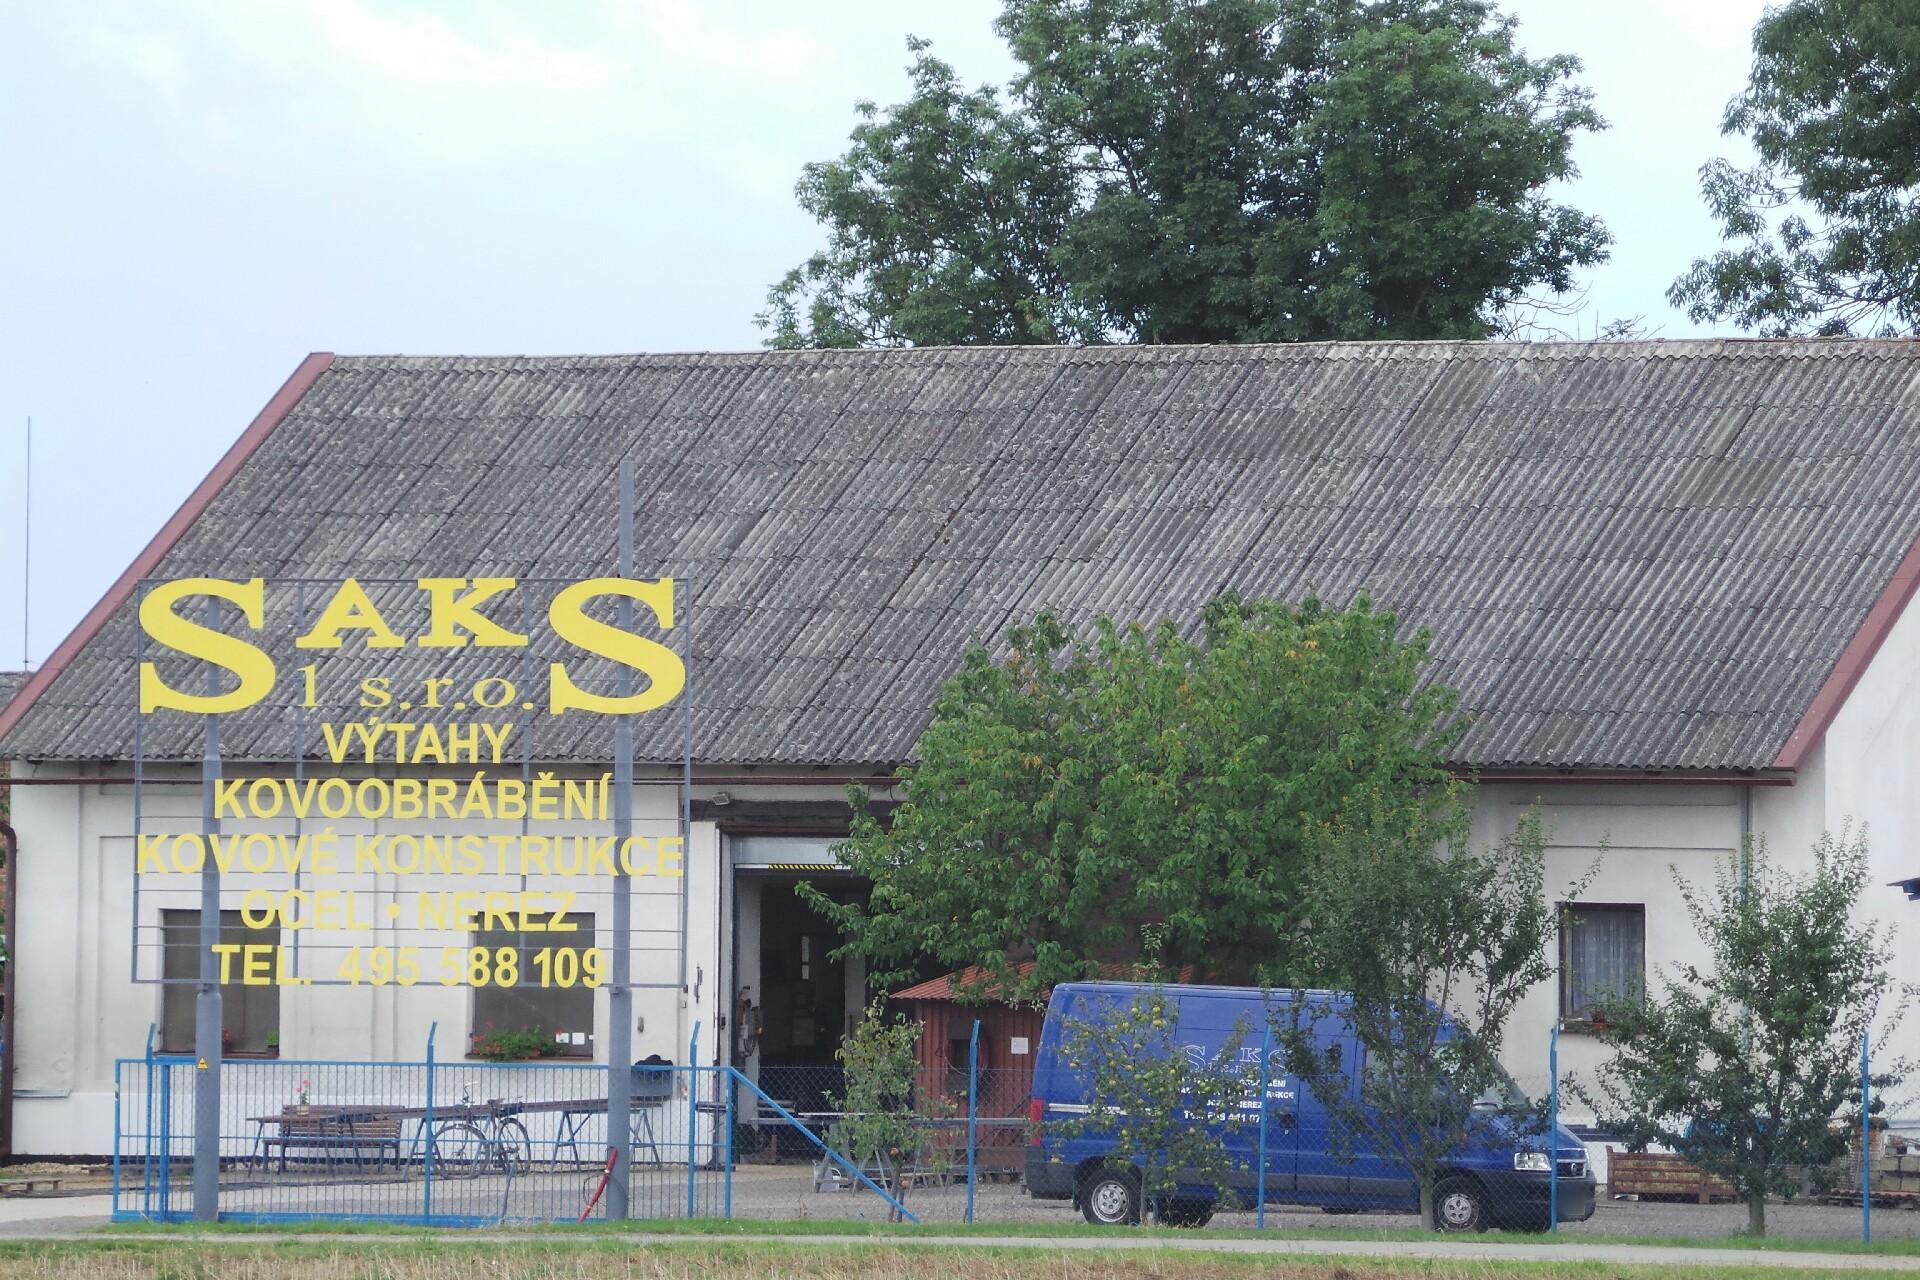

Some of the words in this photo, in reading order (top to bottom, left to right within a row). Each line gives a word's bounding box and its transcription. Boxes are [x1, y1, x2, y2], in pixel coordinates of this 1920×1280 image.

[138, 577, 686, 715] SAKS
[359, 677, 534, 710] s.r.o.
[322, 717, 514, 764] VÝTAHY
[215, 770, 613, 821] KOVOOBRÁBĚNÍ
[137, 829, 337, 875] KOVOVÉ
[355, 835, 685, 878] KONSTRUKCE
[240, 889, 370, 930] OCEL
[417, 892, 578, 933] NEREZ
[212, 943, 312, 986] TEL.
[338, 946, 420, 987] 495
[439, 945, 520, 989] 588
[532, 946, 607, 989] 109
